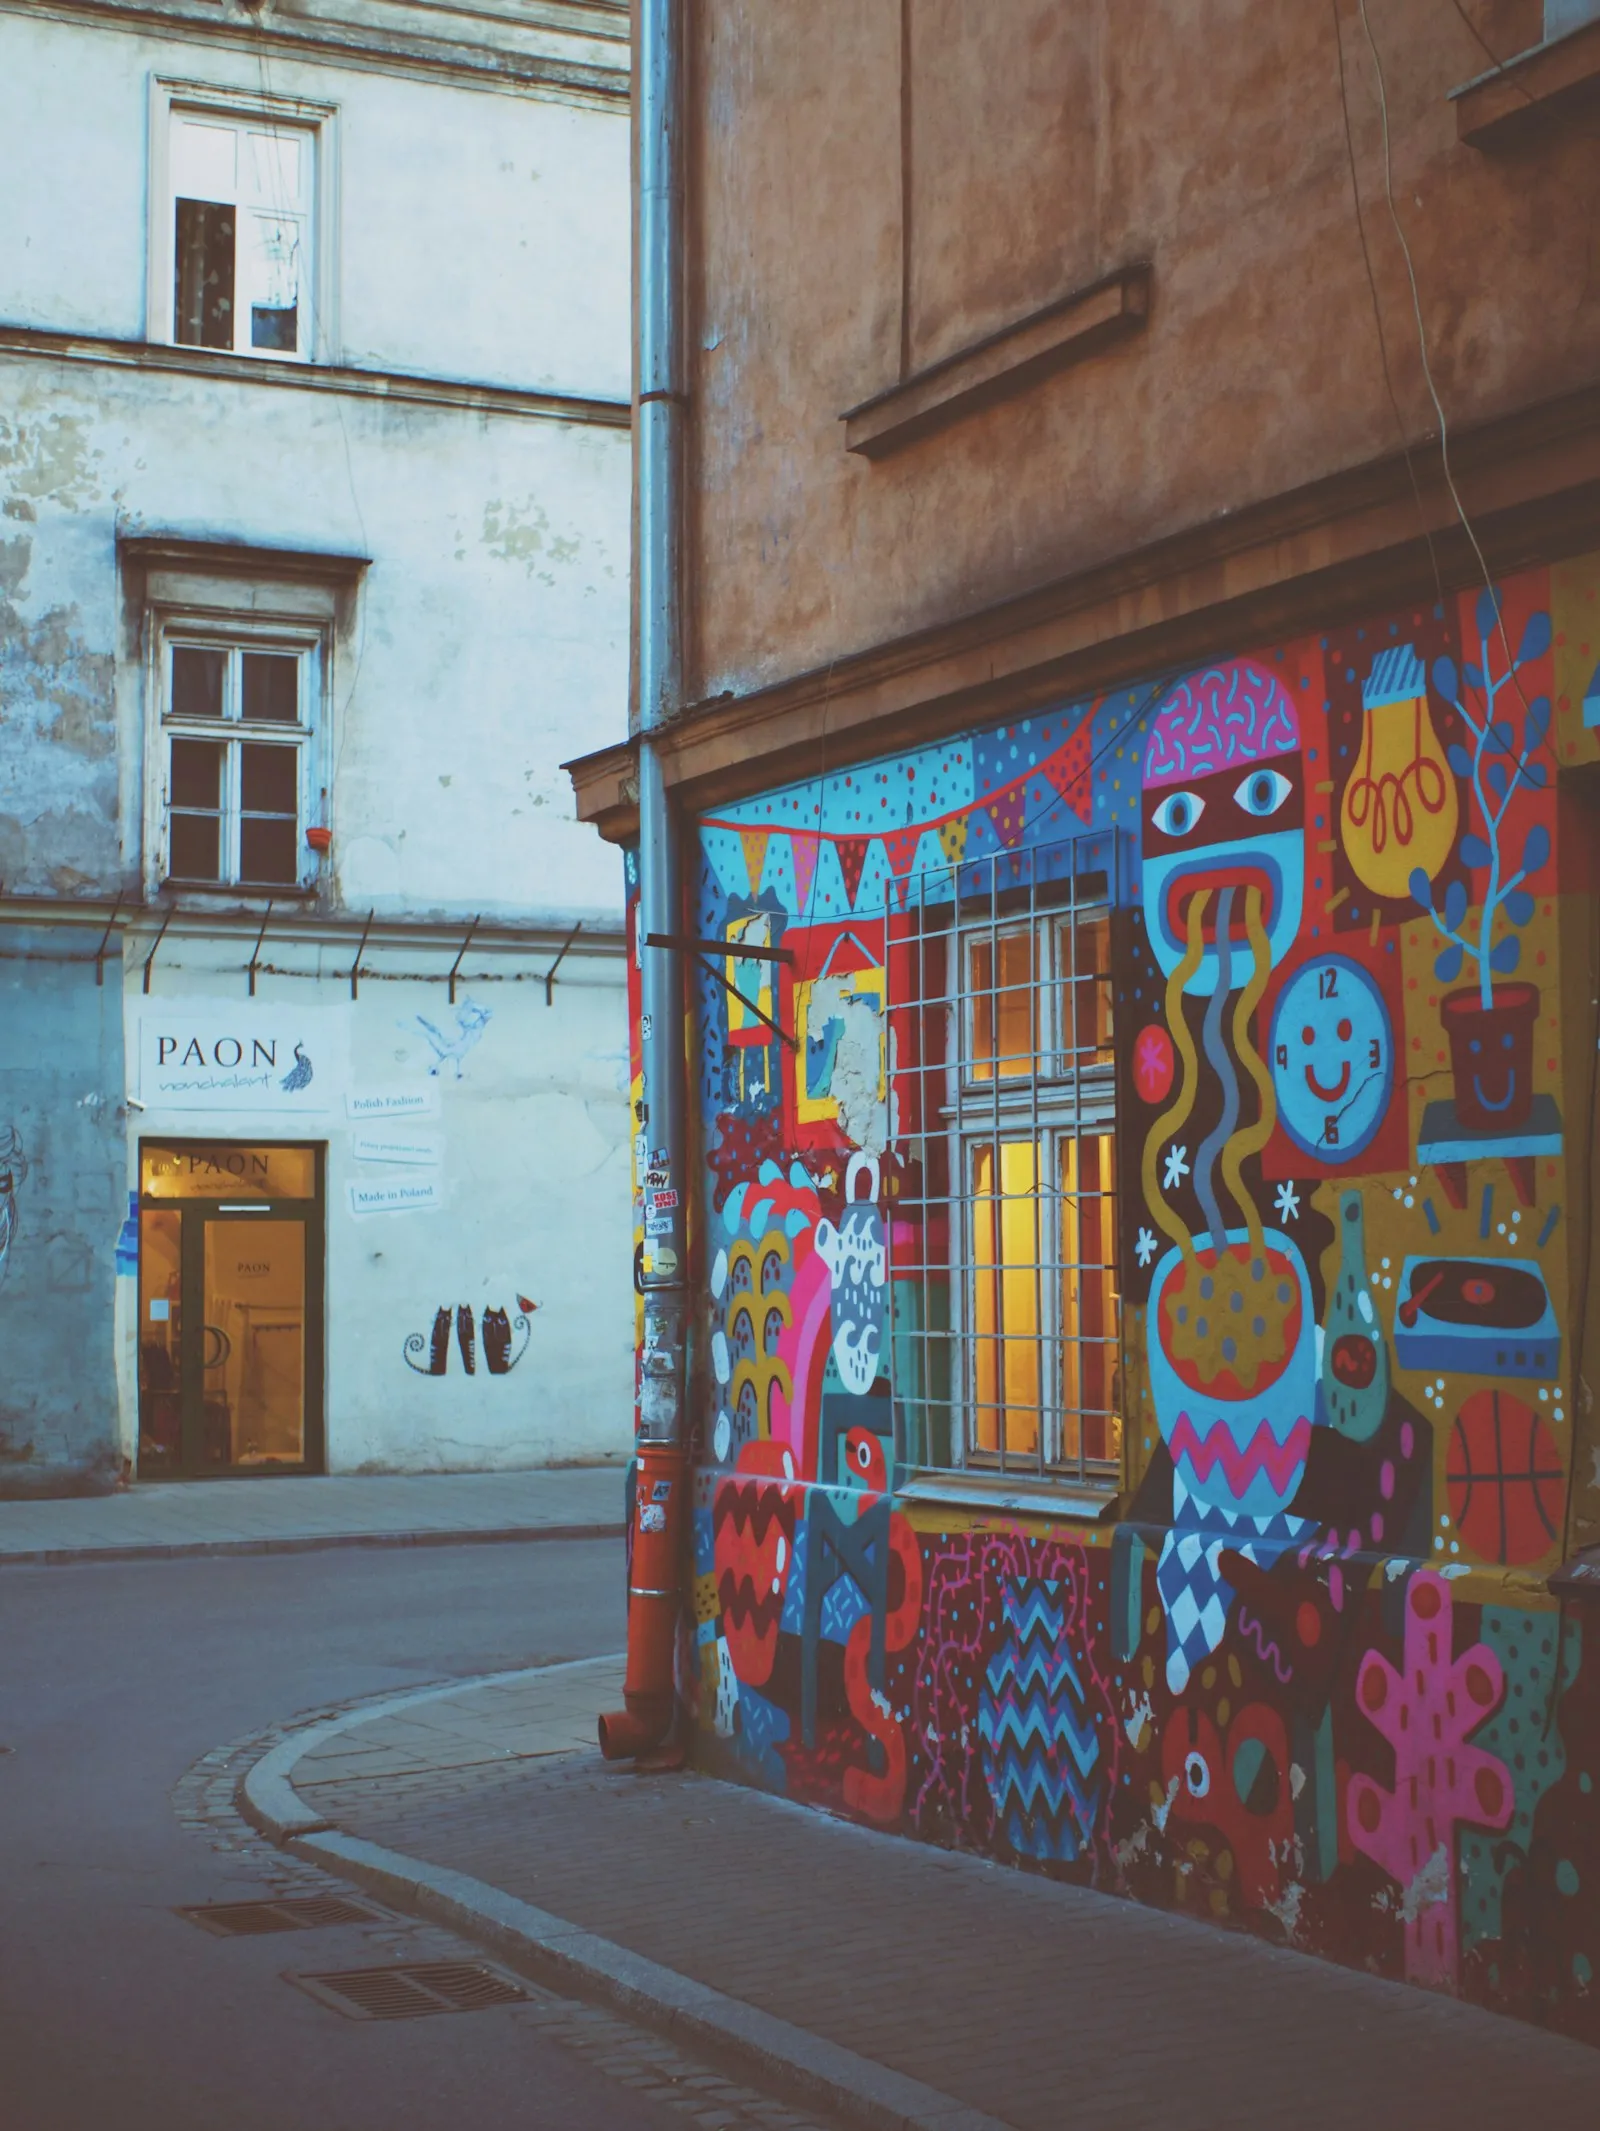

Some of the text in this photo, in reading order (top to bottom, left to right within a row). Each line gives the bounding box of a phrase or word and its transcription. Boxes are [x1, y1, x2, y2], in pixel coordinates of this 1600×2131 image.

[1320, 968, 1338, 1000] 12
[156, 1036, 277, 1067] PAON
[159, 1073, 273, 1093] nonchalant
[353, 1095, 424, 1110] Polish Fashion
[189, 1153, 269, 1175] PAON
[358, 1185, 434, 1203] Made in Poland
[237, 1261, 271, 1273] PAON
